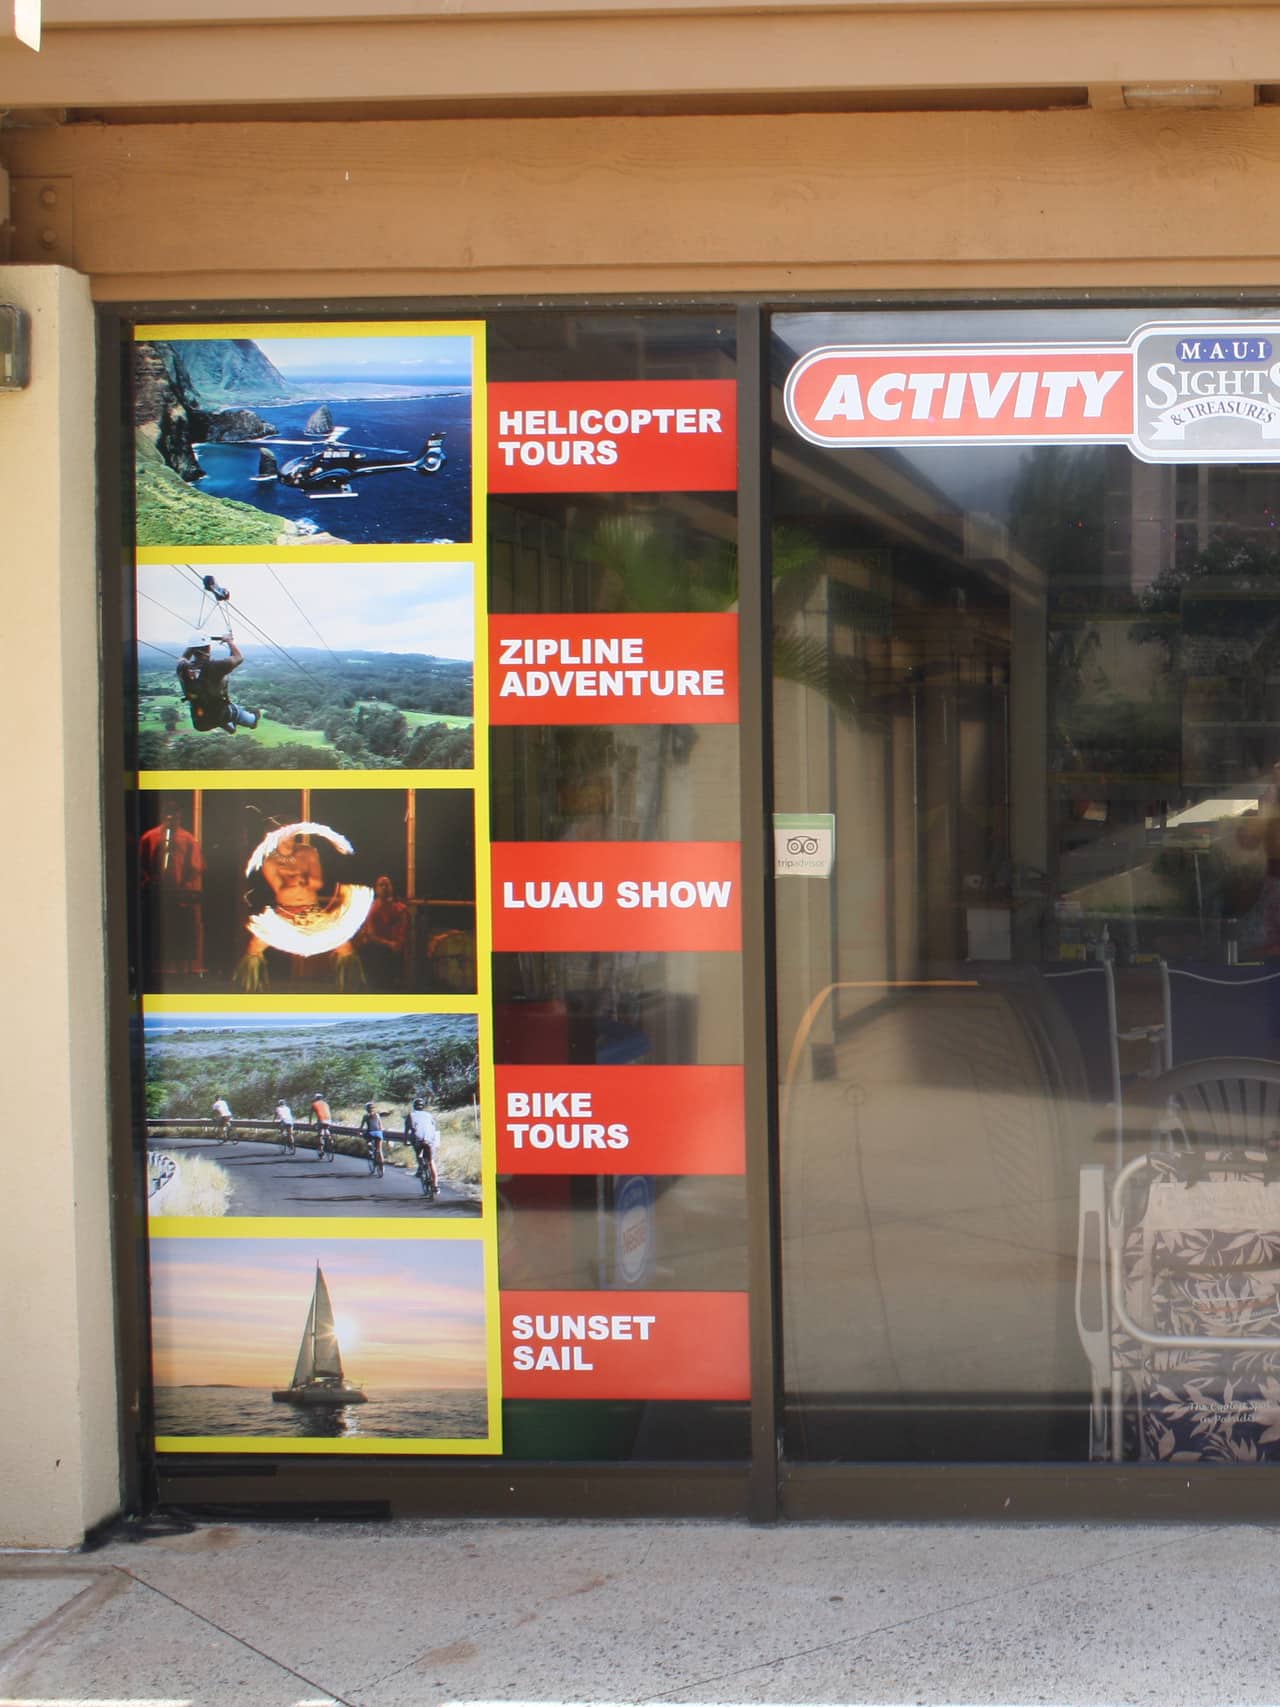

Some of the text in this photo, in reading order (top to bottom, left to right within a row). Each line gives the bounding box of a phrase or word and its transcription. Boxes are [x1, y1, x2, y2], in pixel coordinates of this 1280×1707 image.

[815, 371, 1124, 422] ACTIVITY
[499, 408, 723, 436] HELICOPTER
[1170, 400, 1277, 426] & TREASURES
[497, 439, 618, 466] TOURS
[499, 638, 644, 665] ZIPLINE
[499, 669, 725, 697] ADVENTURE
[503, 880, 732, 909] LUAU SHOW
[507, 1092, 593, 1118] BIKE
[506, 1123, 629, 1149] TOURS
[511, 1314, 656, 1341] SUNSET
[512, 1345, 594, 1371] SAIL
